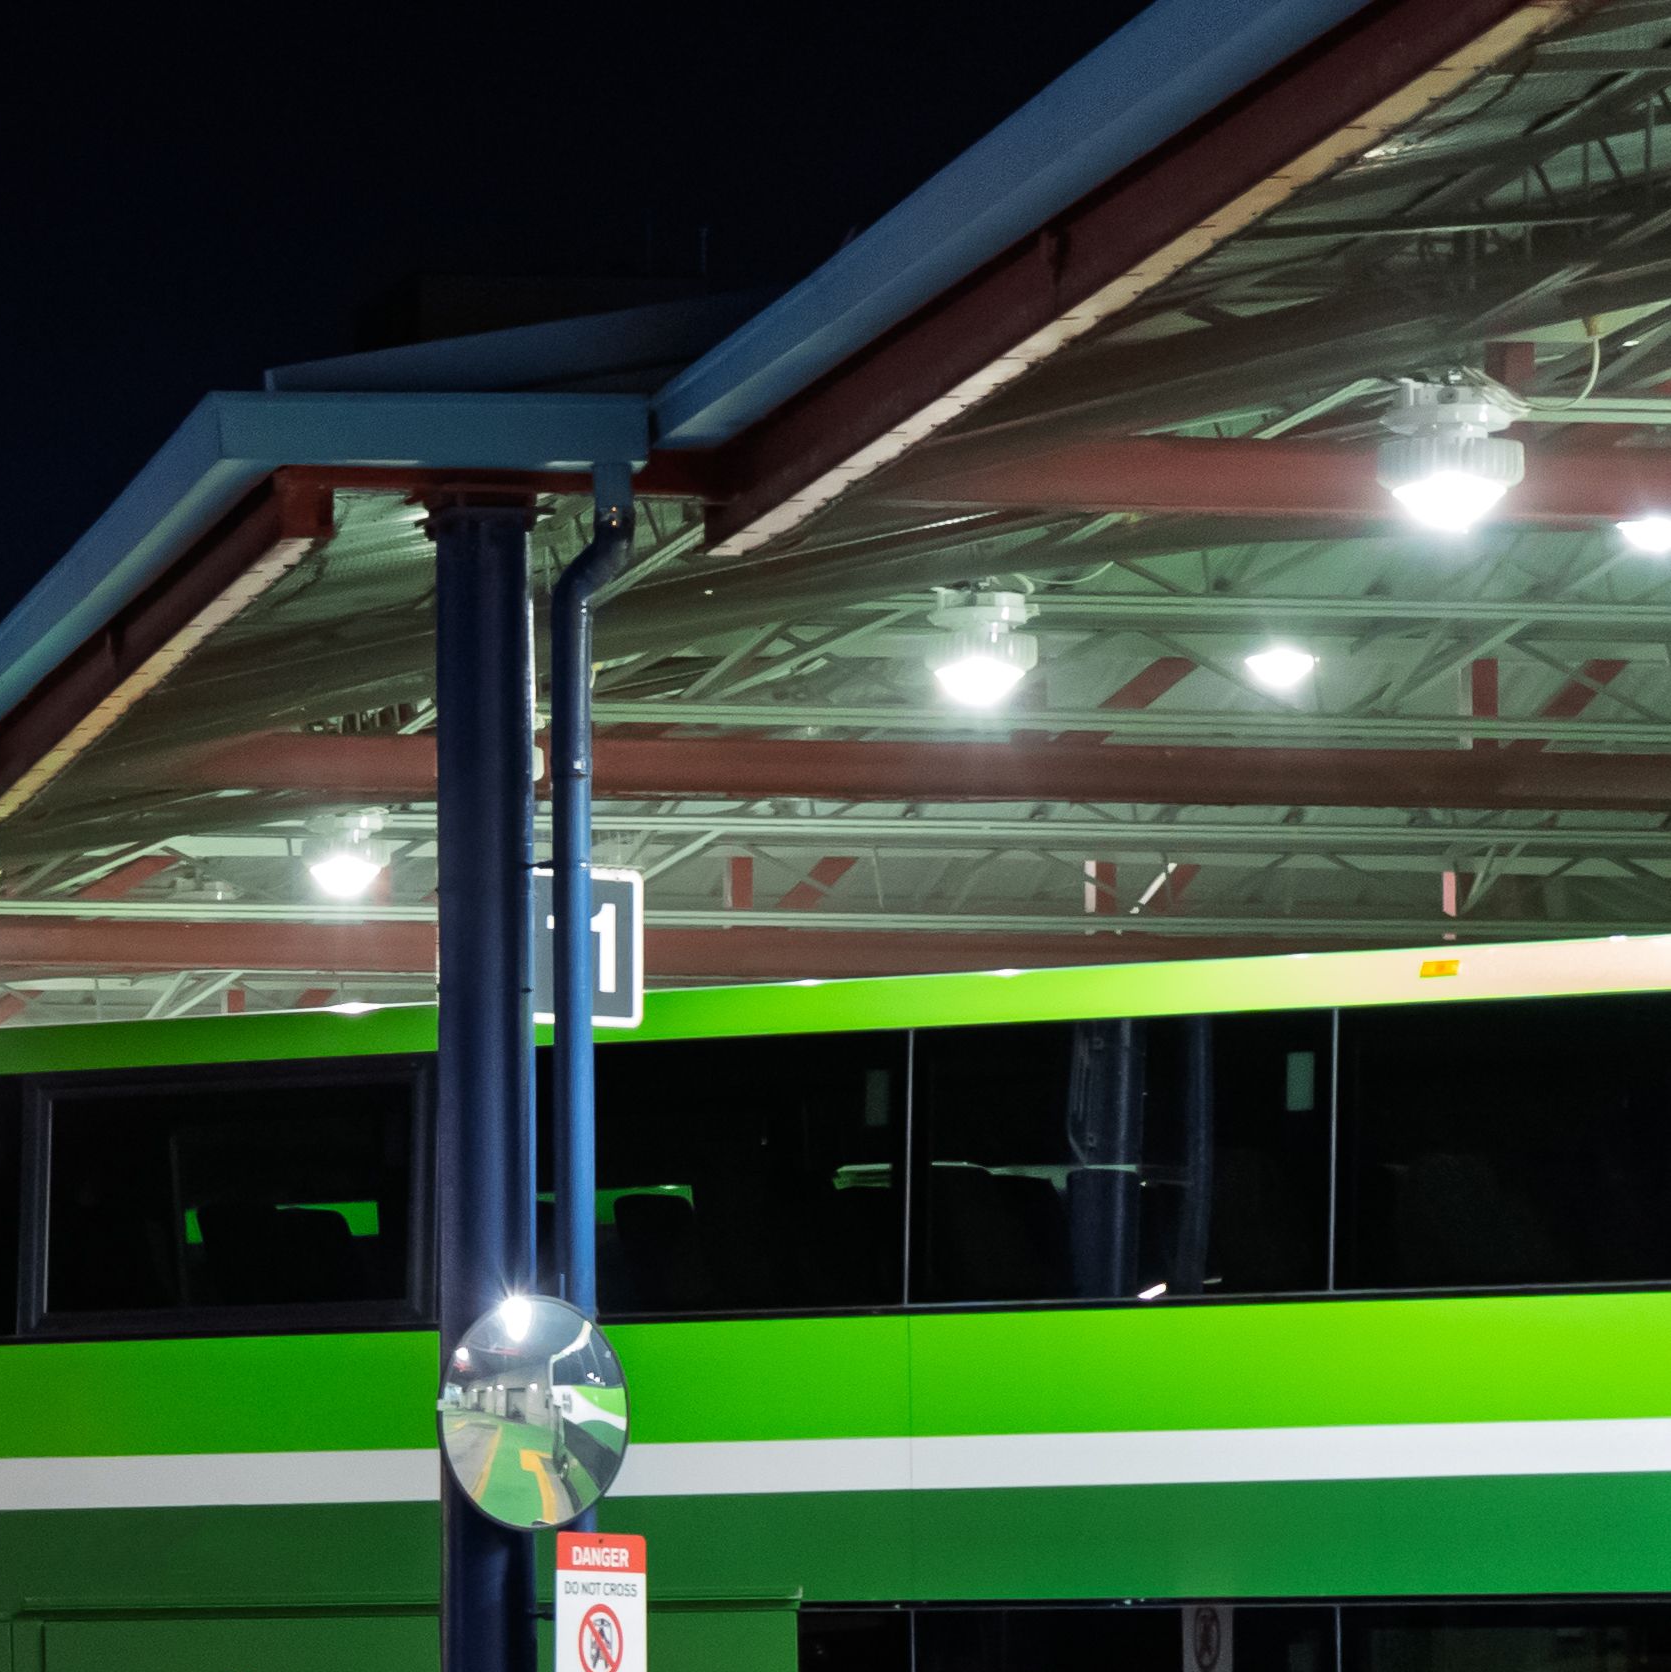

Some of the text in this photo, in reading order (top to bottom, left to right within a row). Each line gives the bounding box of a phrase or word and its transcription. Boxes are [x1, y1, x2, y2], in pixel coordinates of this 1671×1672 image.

[571, 1545, 630, 1568] DANGER
[564, 1580, 638, 1597] DO NOT CROSS
